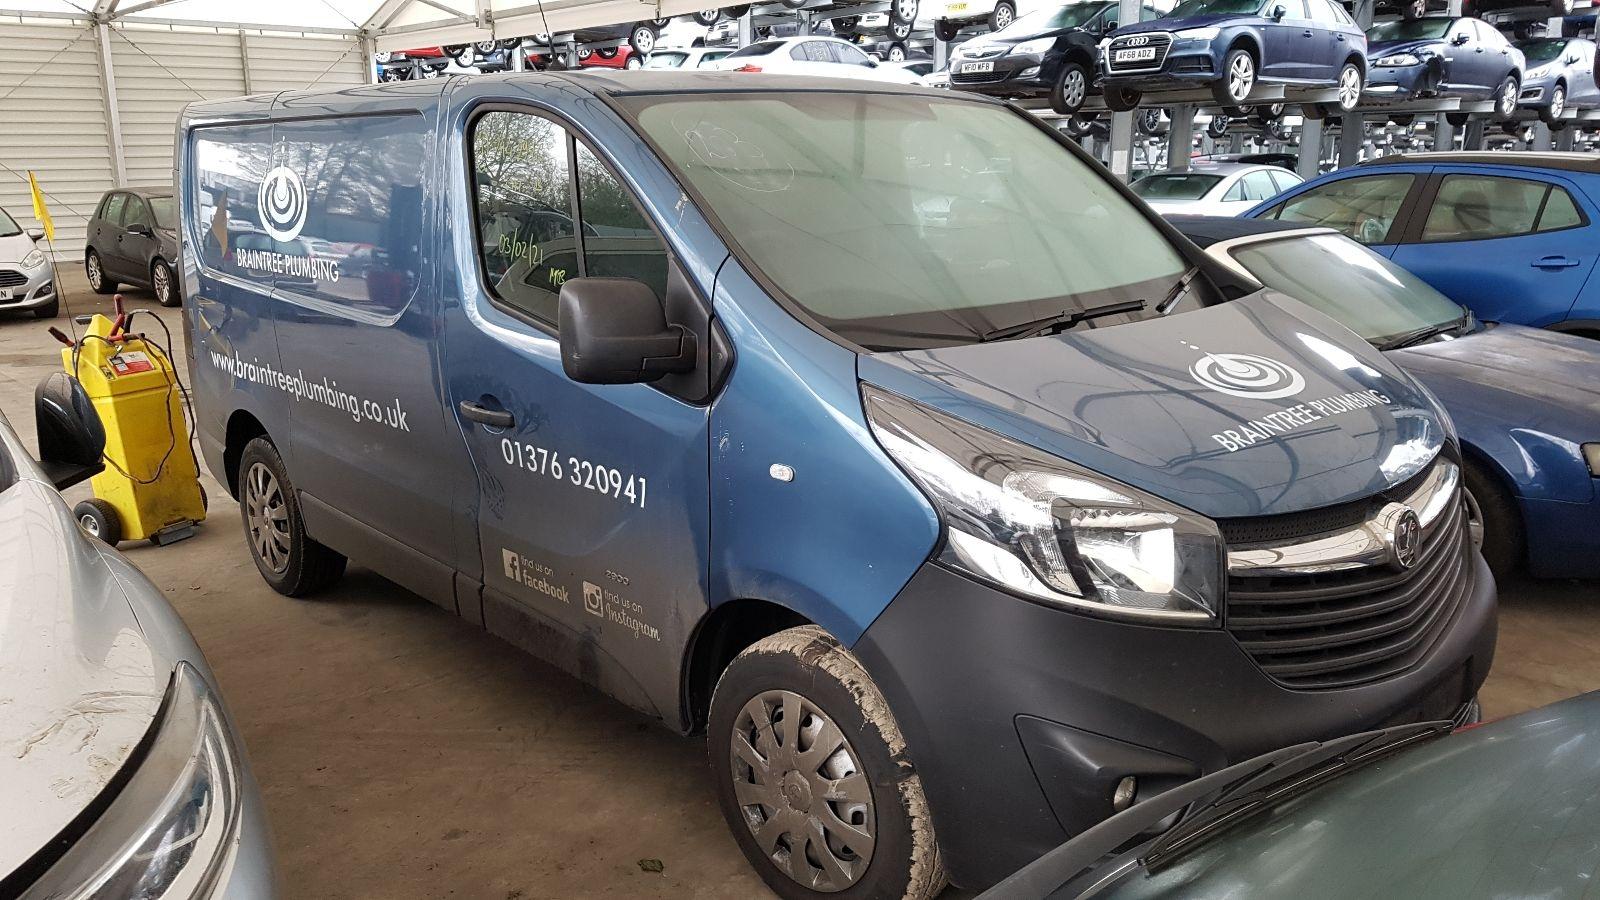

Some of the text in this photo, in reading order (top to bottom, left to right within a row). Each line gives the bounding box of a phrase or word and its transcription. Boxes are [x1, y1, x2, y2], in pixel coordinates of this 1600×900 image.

[1118, 49, 1152, 60] AF68 ADZ
[236, 247, 340, 284] BRAINTREE PLUMBING
[498, 227, 544, 269] 03/02/21
[210, 349, 410, 432] www.braintreeplumbing.co.uk
[1211, 389, 1391, 452] BRAINTREE PLUMBING
[501, 437, 648, 509] 01376 320941
[521, 554, 554, 577] find us on
[523, 568, 570, 604] facebook
[604, 588, 643, 615] find us on
[605, 602, 661, 642] Instagram
